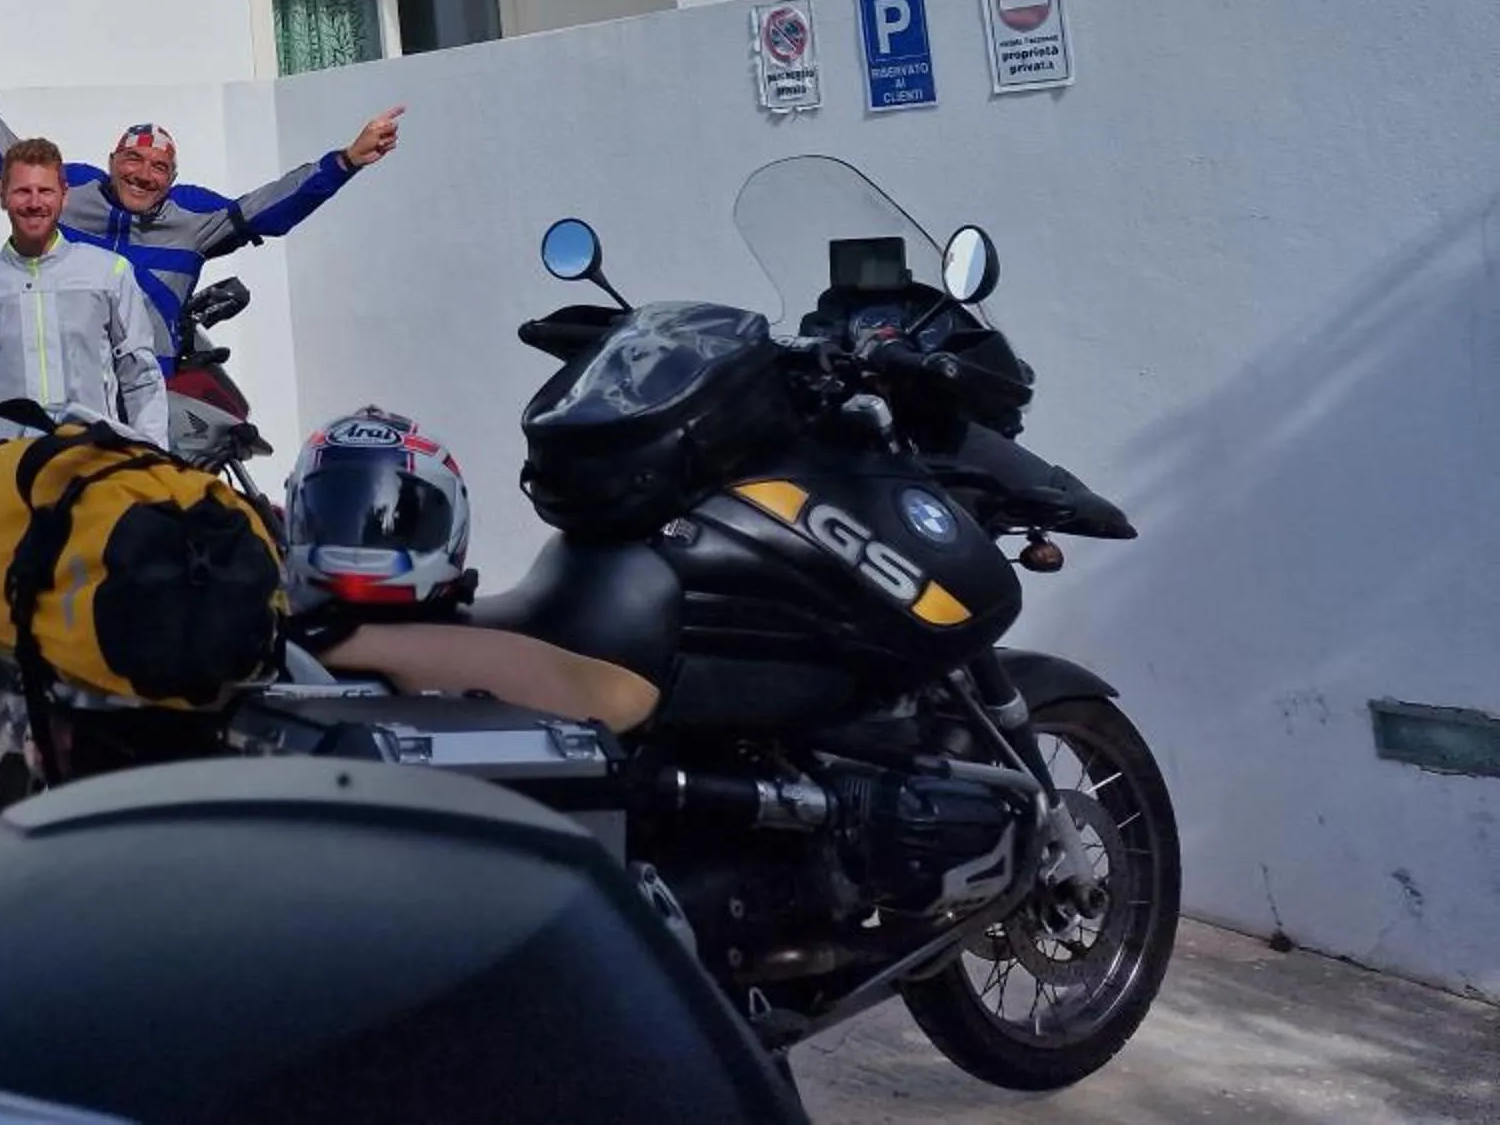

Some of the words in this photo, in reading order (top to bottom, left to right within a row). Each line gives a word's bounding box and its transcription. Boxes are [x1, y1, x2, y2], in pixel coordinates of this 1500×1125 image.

[871, 62, 929, 79] RISERVATO
[883, 89, 924, 103] CLIENTI
[344, 423, 394, 440] Arai
[807, 504, 924, 601] GS
